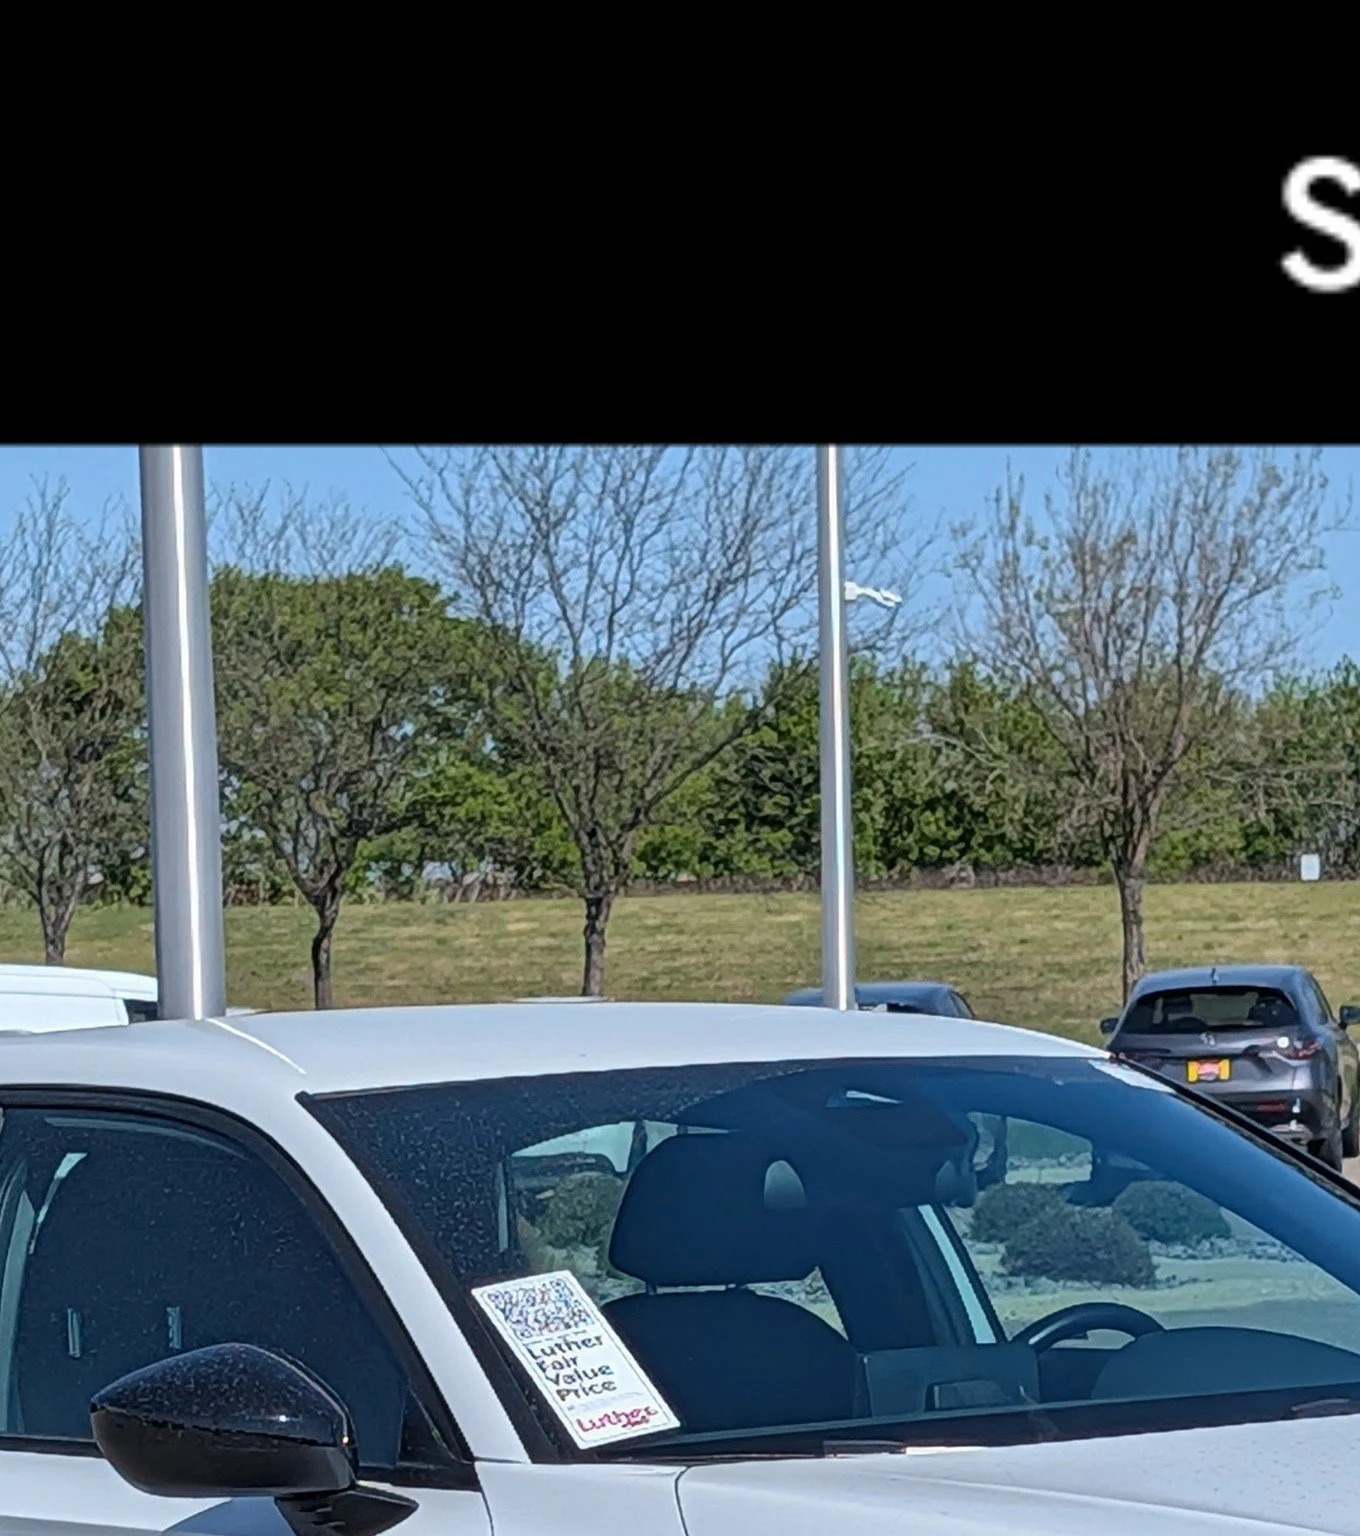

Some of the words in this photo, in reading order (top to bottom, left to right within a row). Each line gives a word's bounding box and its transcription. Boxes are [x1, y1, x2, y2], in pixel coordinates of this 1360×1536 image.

[527, 1334, 604, 1361] Luther
[537, 1355, 580, 1374] Fair
[544, 1363, 615, 1387] Value
[555, 1378, 618, 1403] Price
[576, 1405, 659, 1433] Luther
